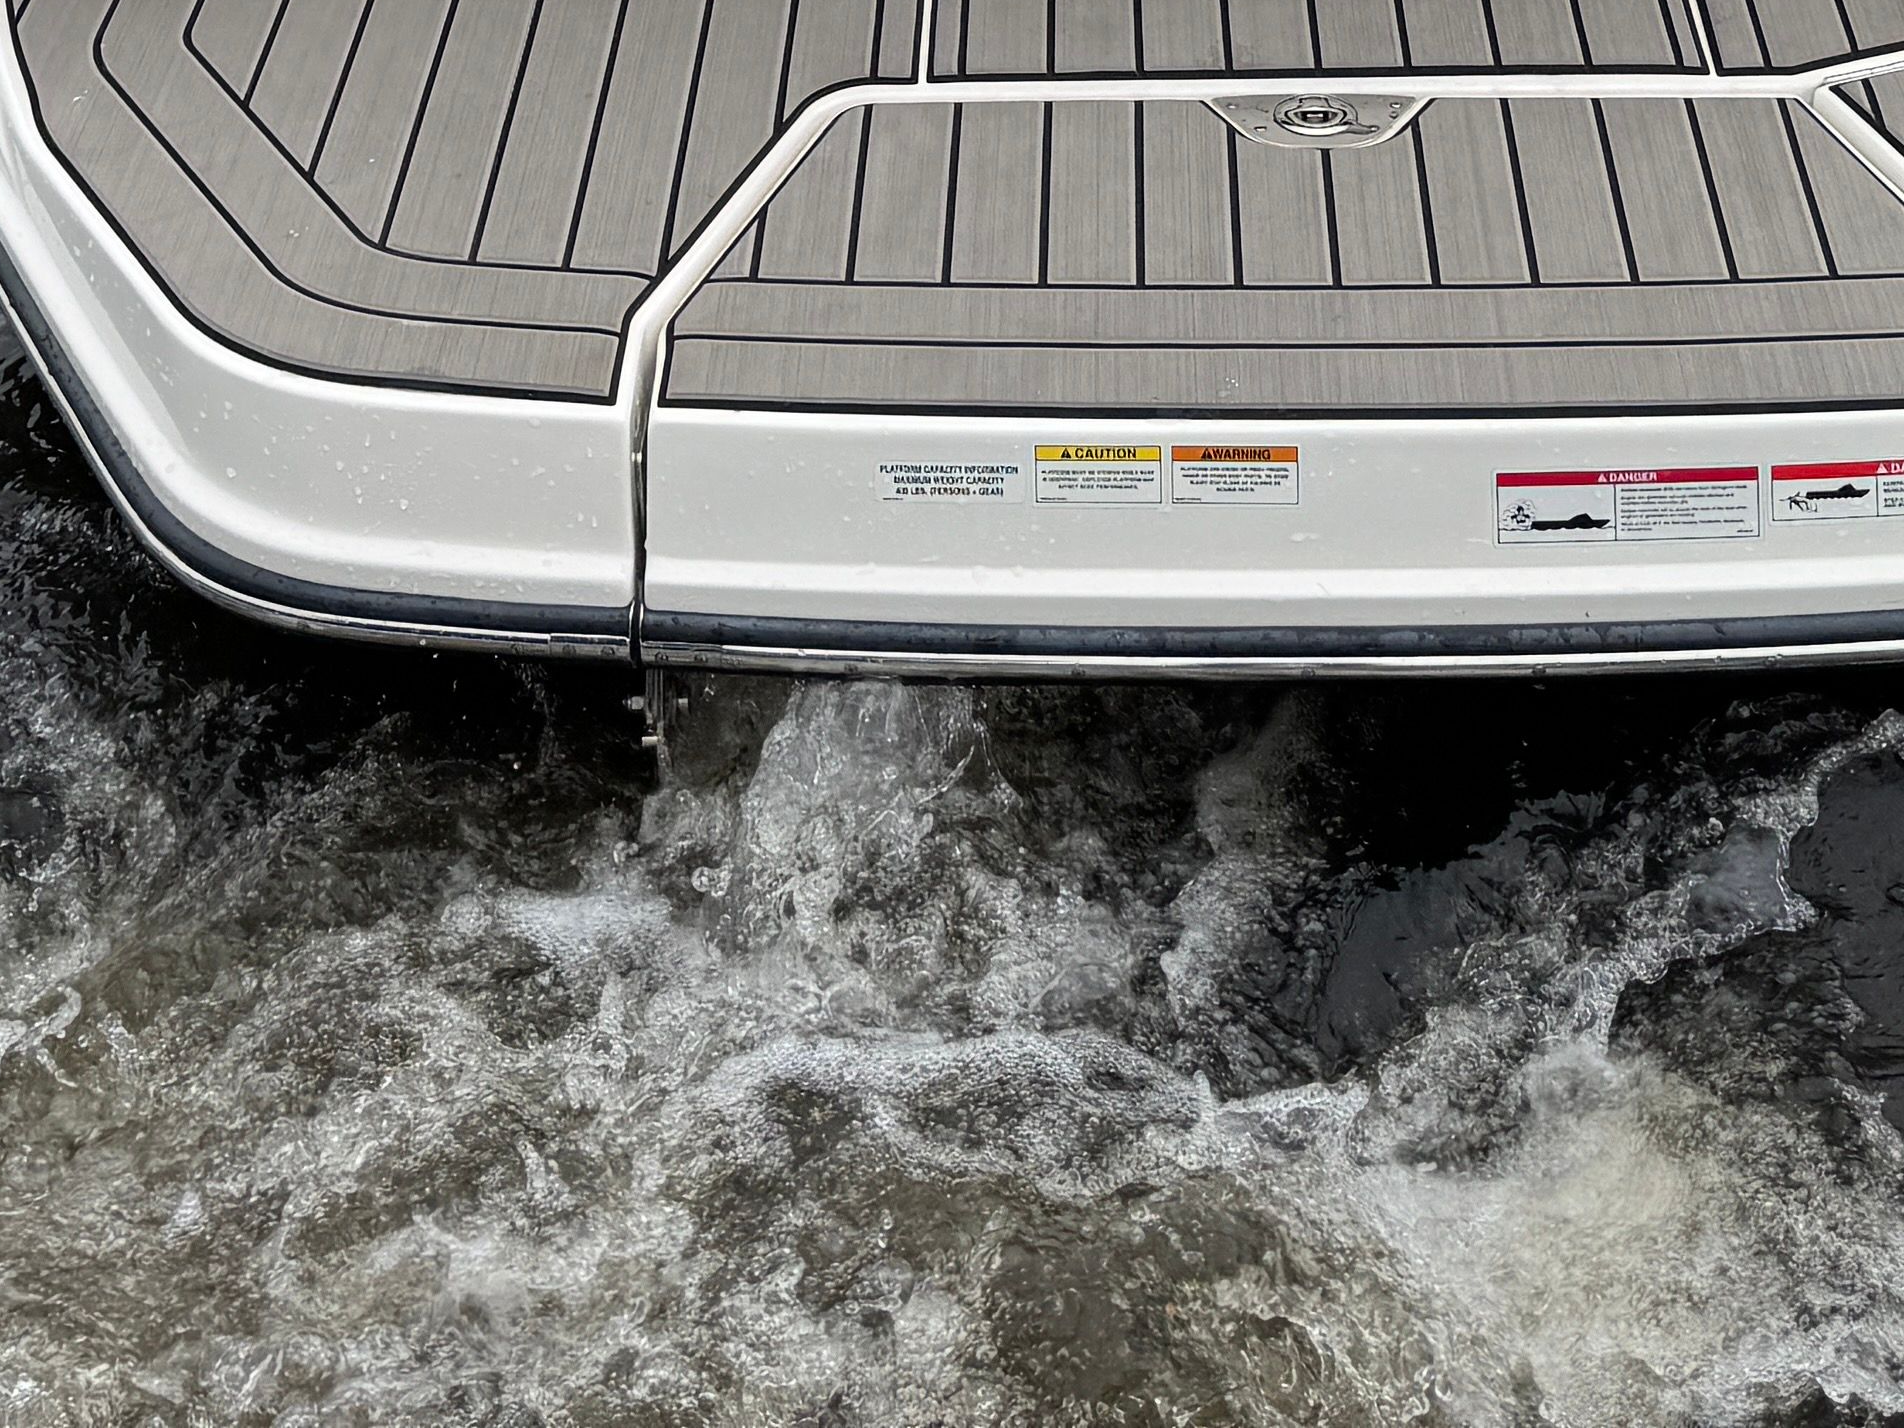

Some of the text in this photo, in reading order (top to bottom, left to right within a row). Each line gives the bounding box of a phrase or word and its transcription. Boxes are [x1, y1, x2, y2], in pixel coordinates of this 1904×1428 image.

[1074, 447, 1137, 459] CAUTION
[1212, 448, 1271, 460] WARNING
[1608, 471, 1657, 482] DANGER
